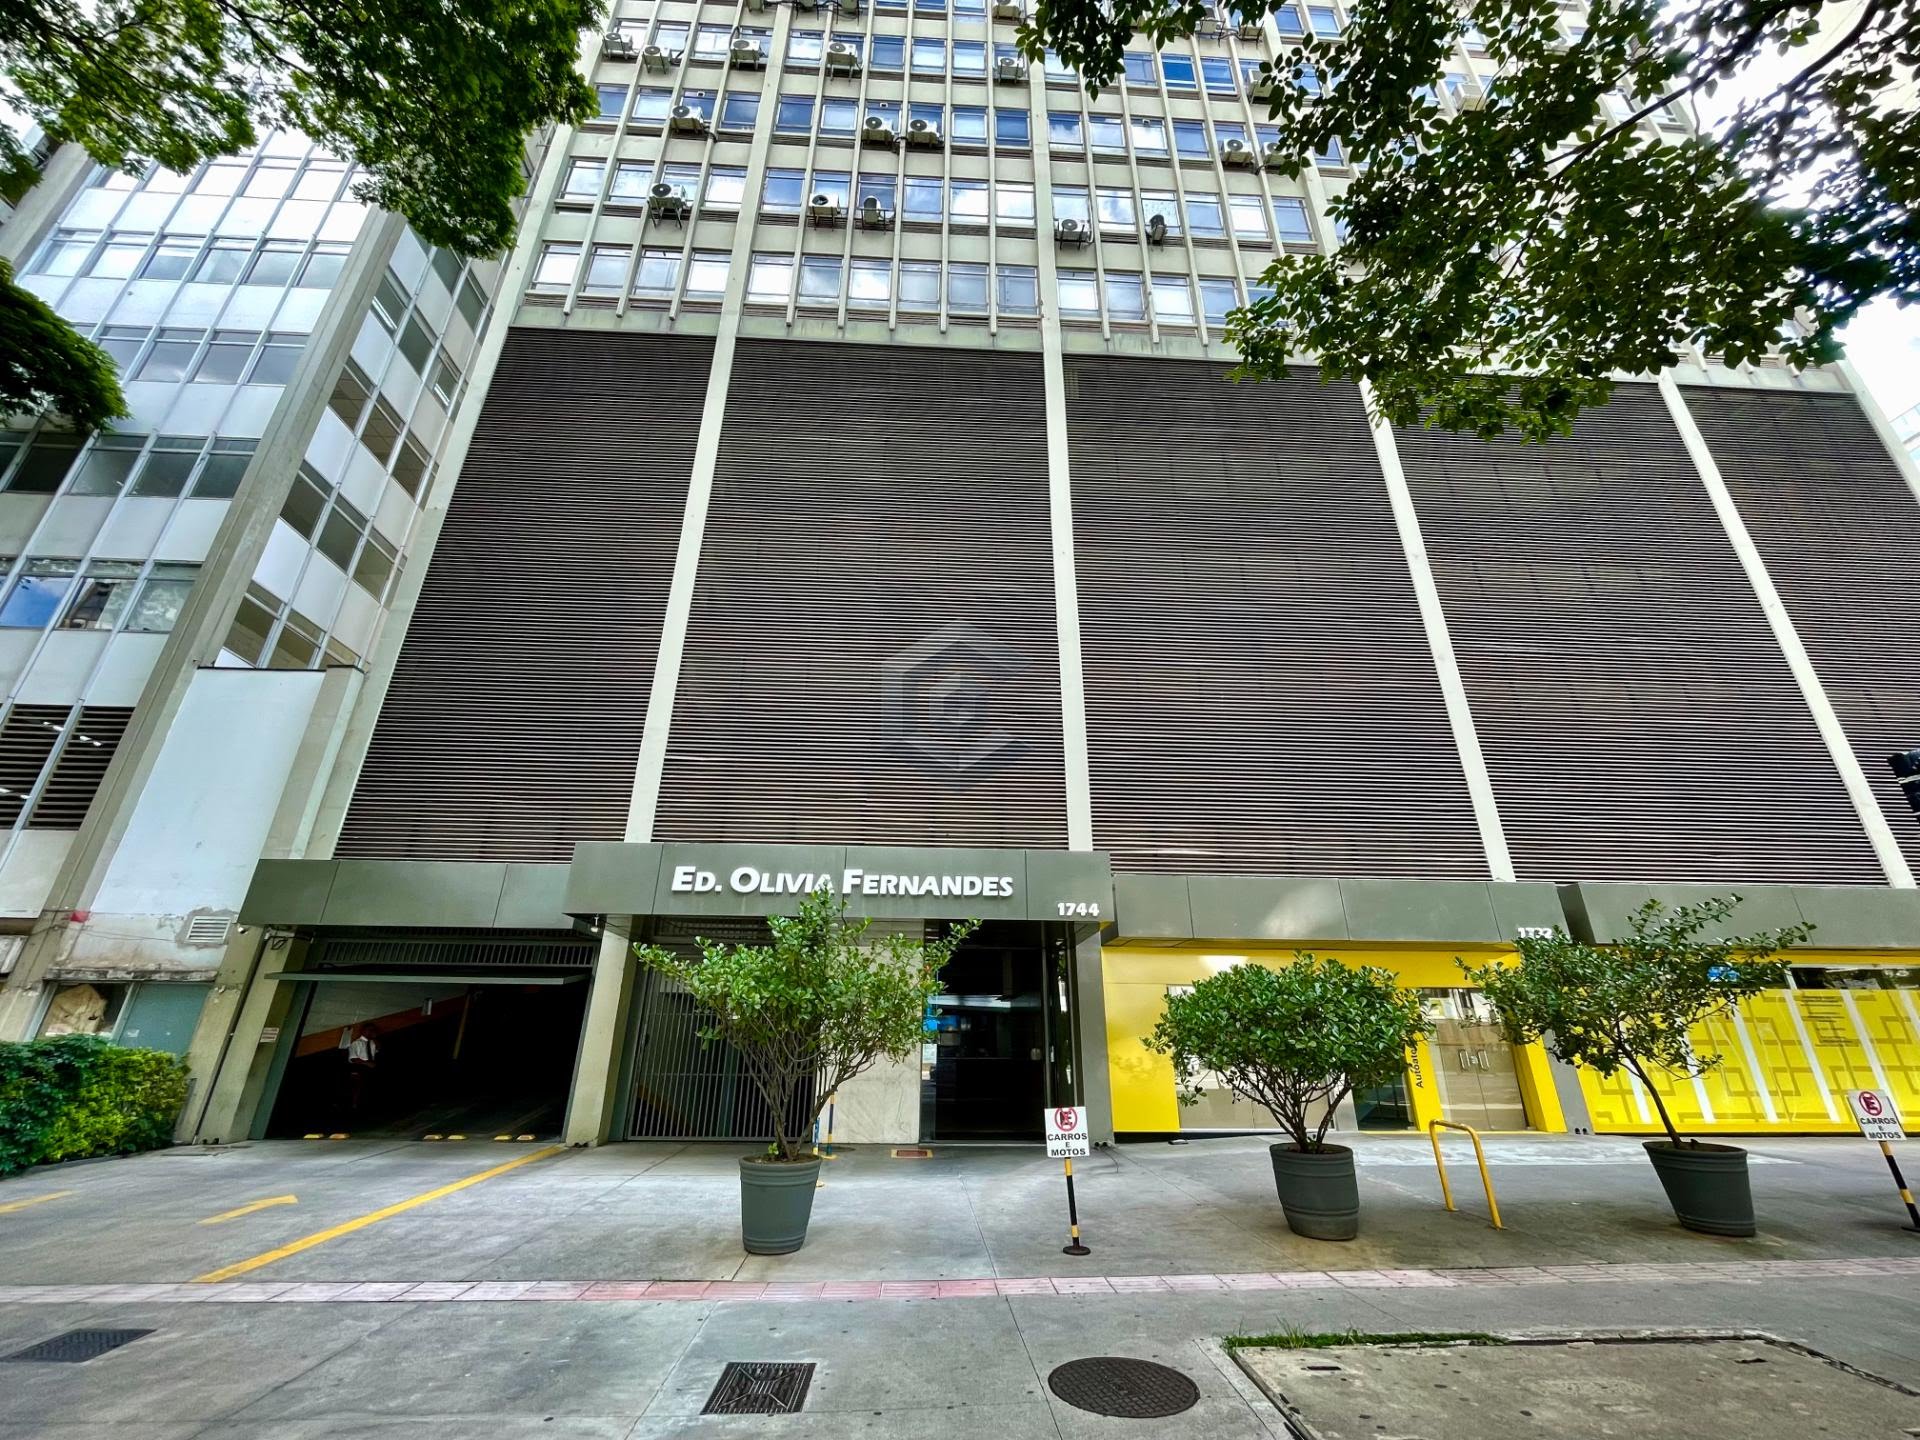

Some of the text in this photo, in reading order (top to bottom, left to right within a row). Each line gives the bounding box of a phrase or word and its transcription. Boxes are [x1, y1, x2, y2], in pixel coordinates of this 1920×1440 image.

[1057, 902, 1100, 917] 1744
[1860, 1117, 1897, 1125] CARROS
[1047, 1133, 1087, 1141] CARROS
[1868, 1131, 1901, 1139] MOTOS
[1051, 1148, 1086, 1156] MOTOS
